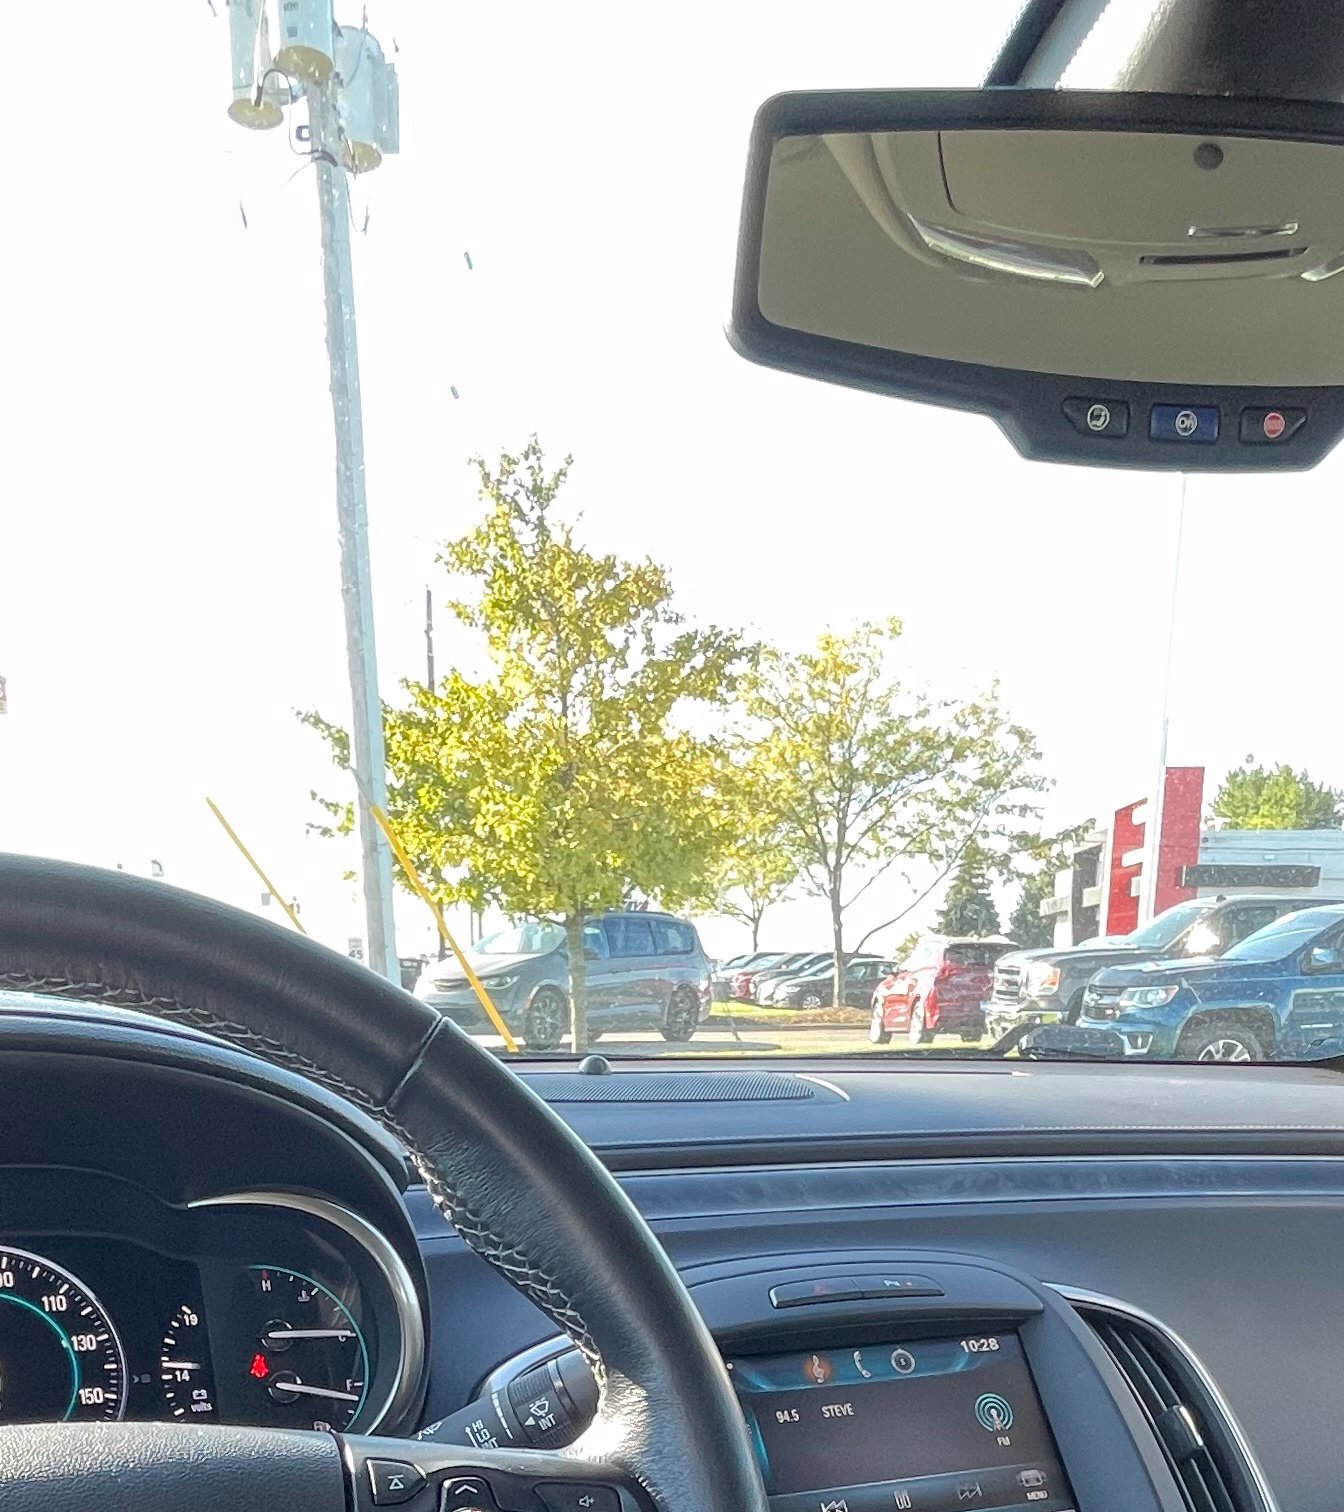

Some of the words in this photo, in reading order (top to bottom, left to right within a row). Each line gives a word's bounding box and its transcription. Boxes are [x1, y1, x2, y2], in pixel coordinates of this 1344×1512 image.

[261, 1280, 272, 1292] H
[41, 1295, 67, 1312] 110
[182, 1314, 199, 1326] 19
[71, 1335, 97, 1351] 130
[960, 1337, 999, 1353] 10:28
[174, 1370, 191, 1383] 14
[78, 1387, 104, 1405] 150
[776, 1409, 800, 1424] 94.5
[821, 1403, 855, 1419] STEVE
[472, 1419, 484, 1432] HI
[538, 1413, 556, 1431] INT
[476, 1429, 491, 1443] LO
[997, 1436, 1011, 1447] FM
